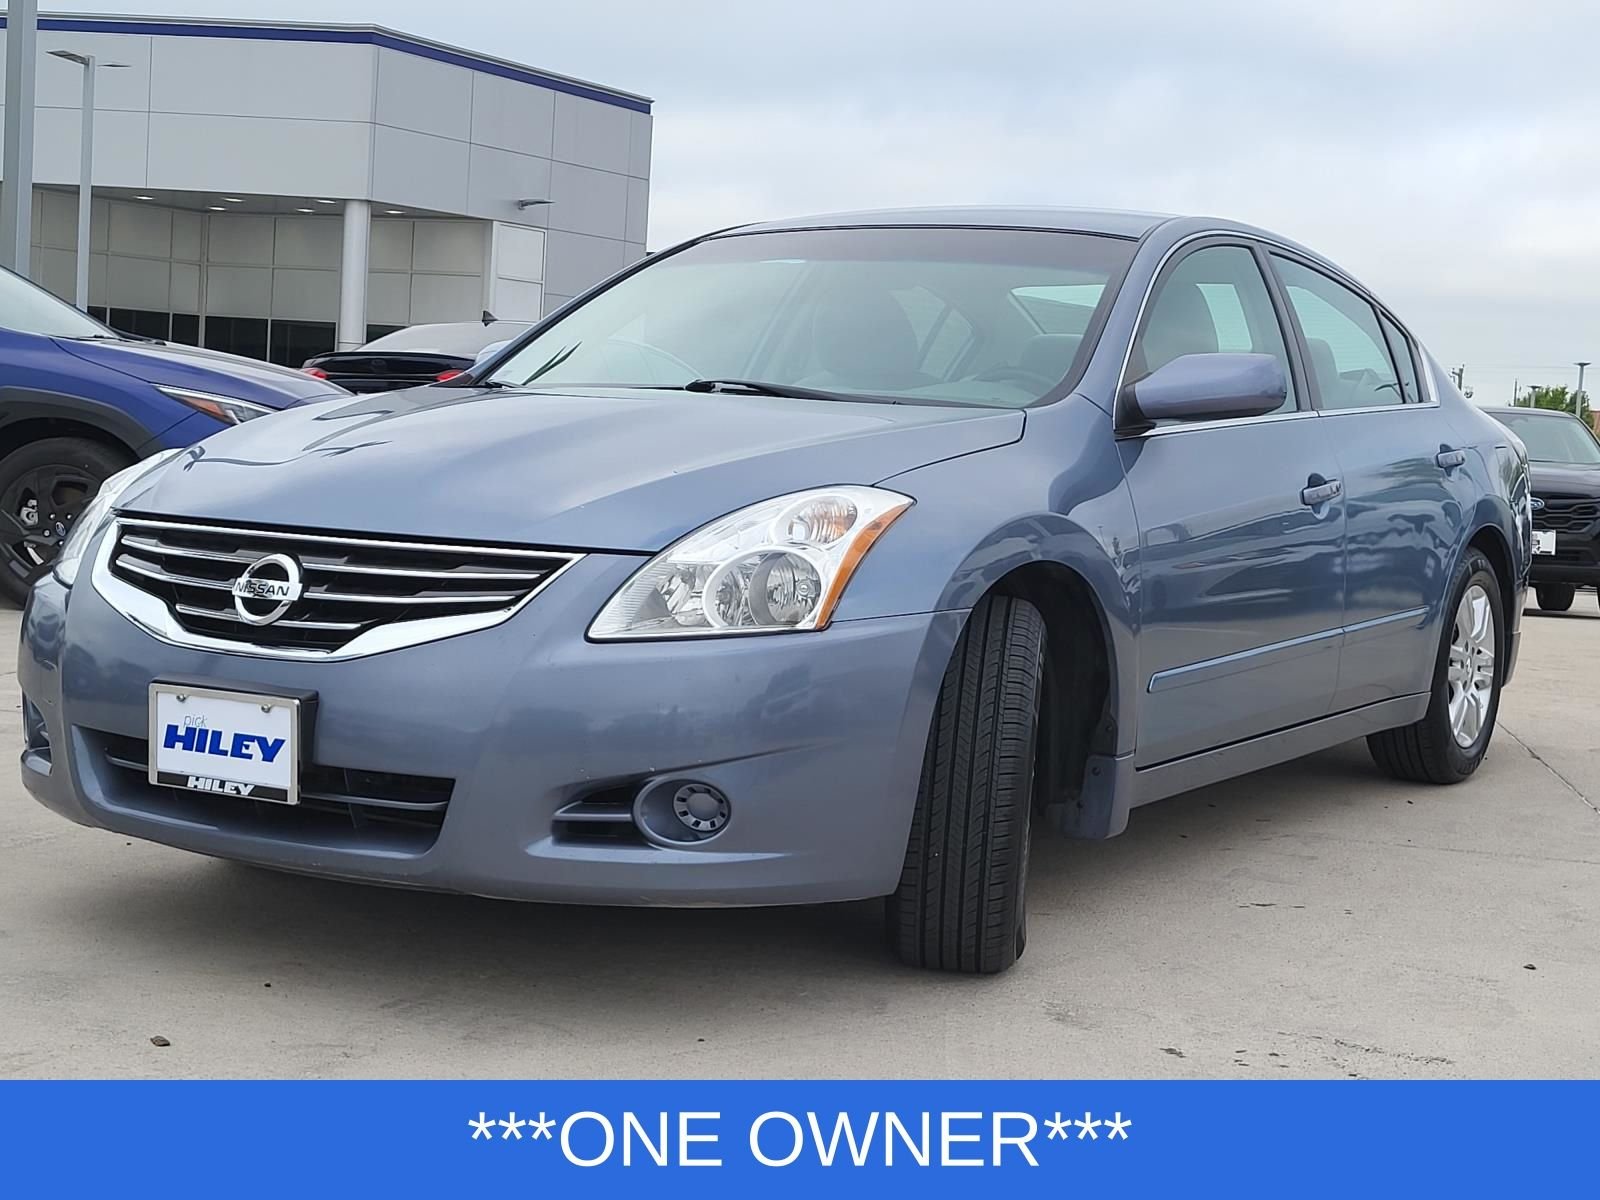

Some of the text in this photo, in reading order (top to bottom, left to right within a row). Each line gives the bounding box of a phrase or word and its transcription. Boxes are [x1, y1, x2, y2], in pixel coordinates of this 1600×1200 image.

[235, 582, 290, 596] NISSAN
[183, 714, 208, 728] pick
[163, 724, 286, 763] HILEY
[187, 776, 256, 796] HILEY
